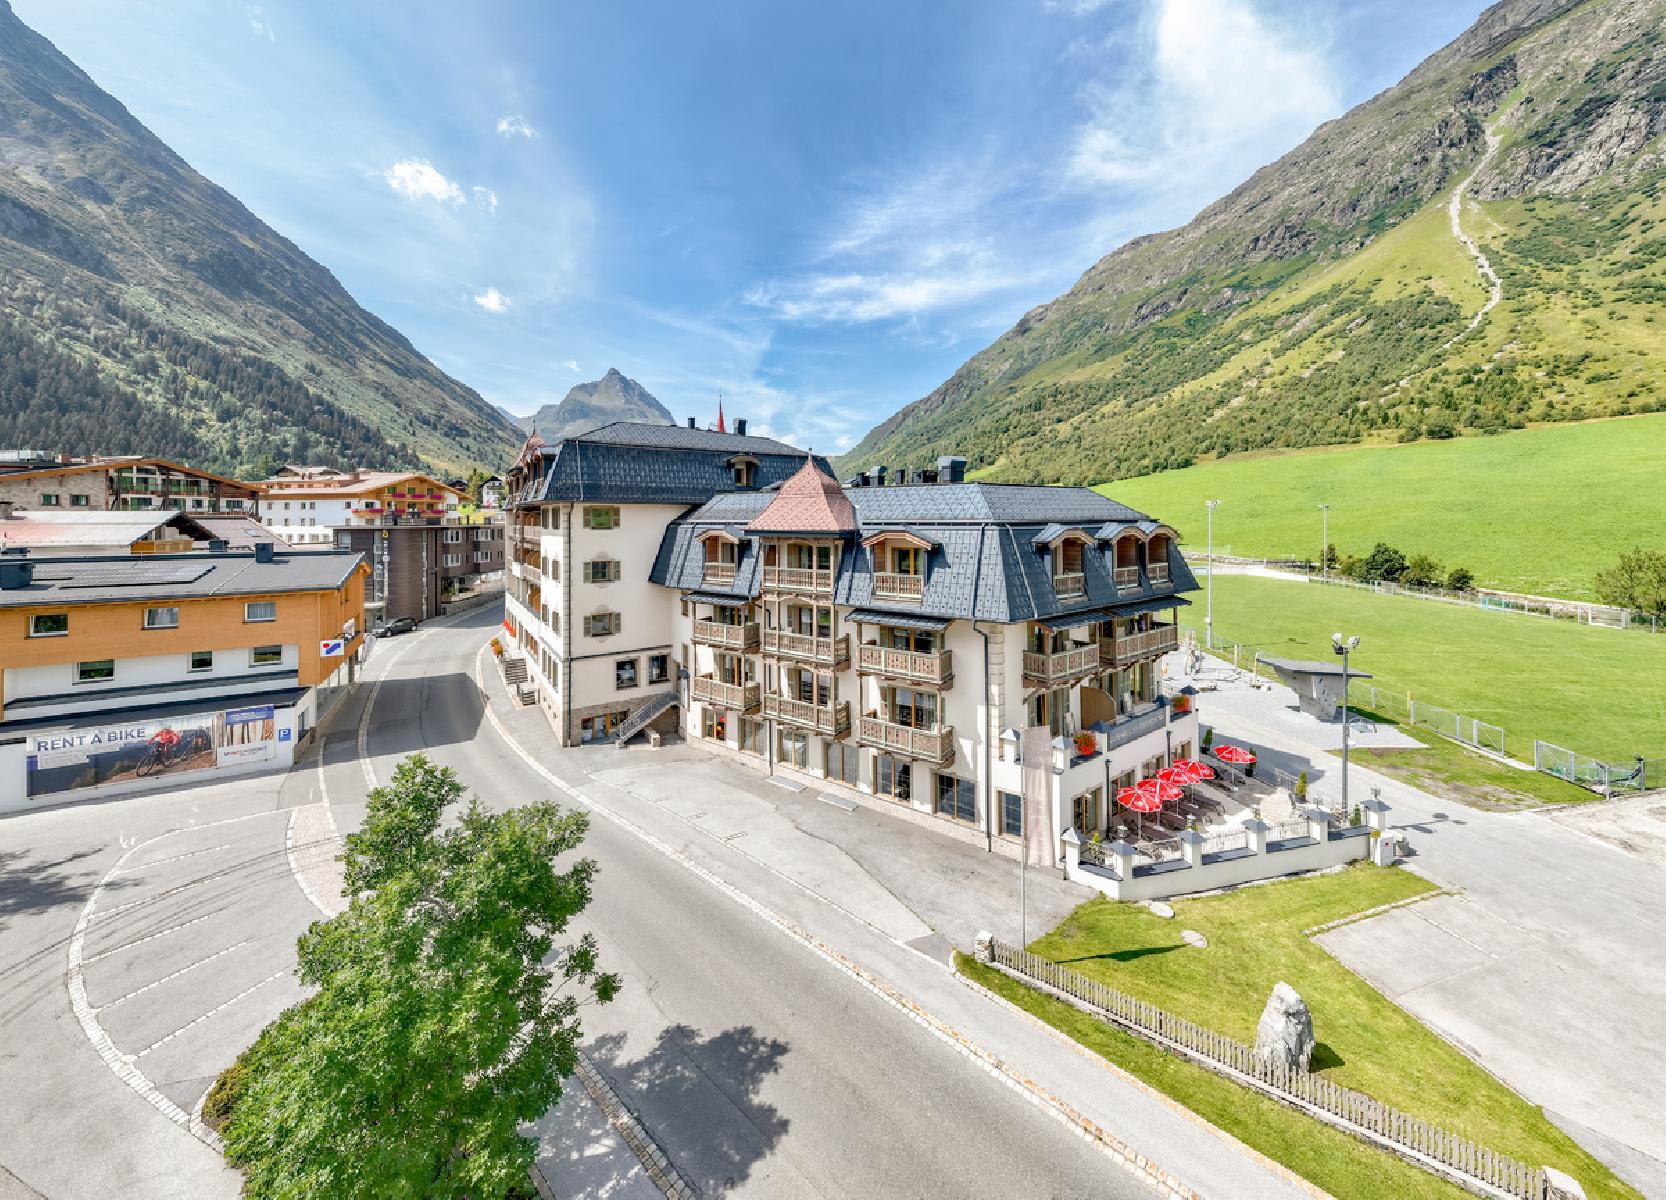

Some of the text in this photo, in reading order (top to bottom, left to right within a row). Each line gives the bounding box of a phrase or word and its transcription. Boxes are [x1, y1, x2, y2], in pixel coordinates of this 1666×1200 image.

[37, 728, 146, 752] RENT A BIKE
[280, 729, 289, 738] P
